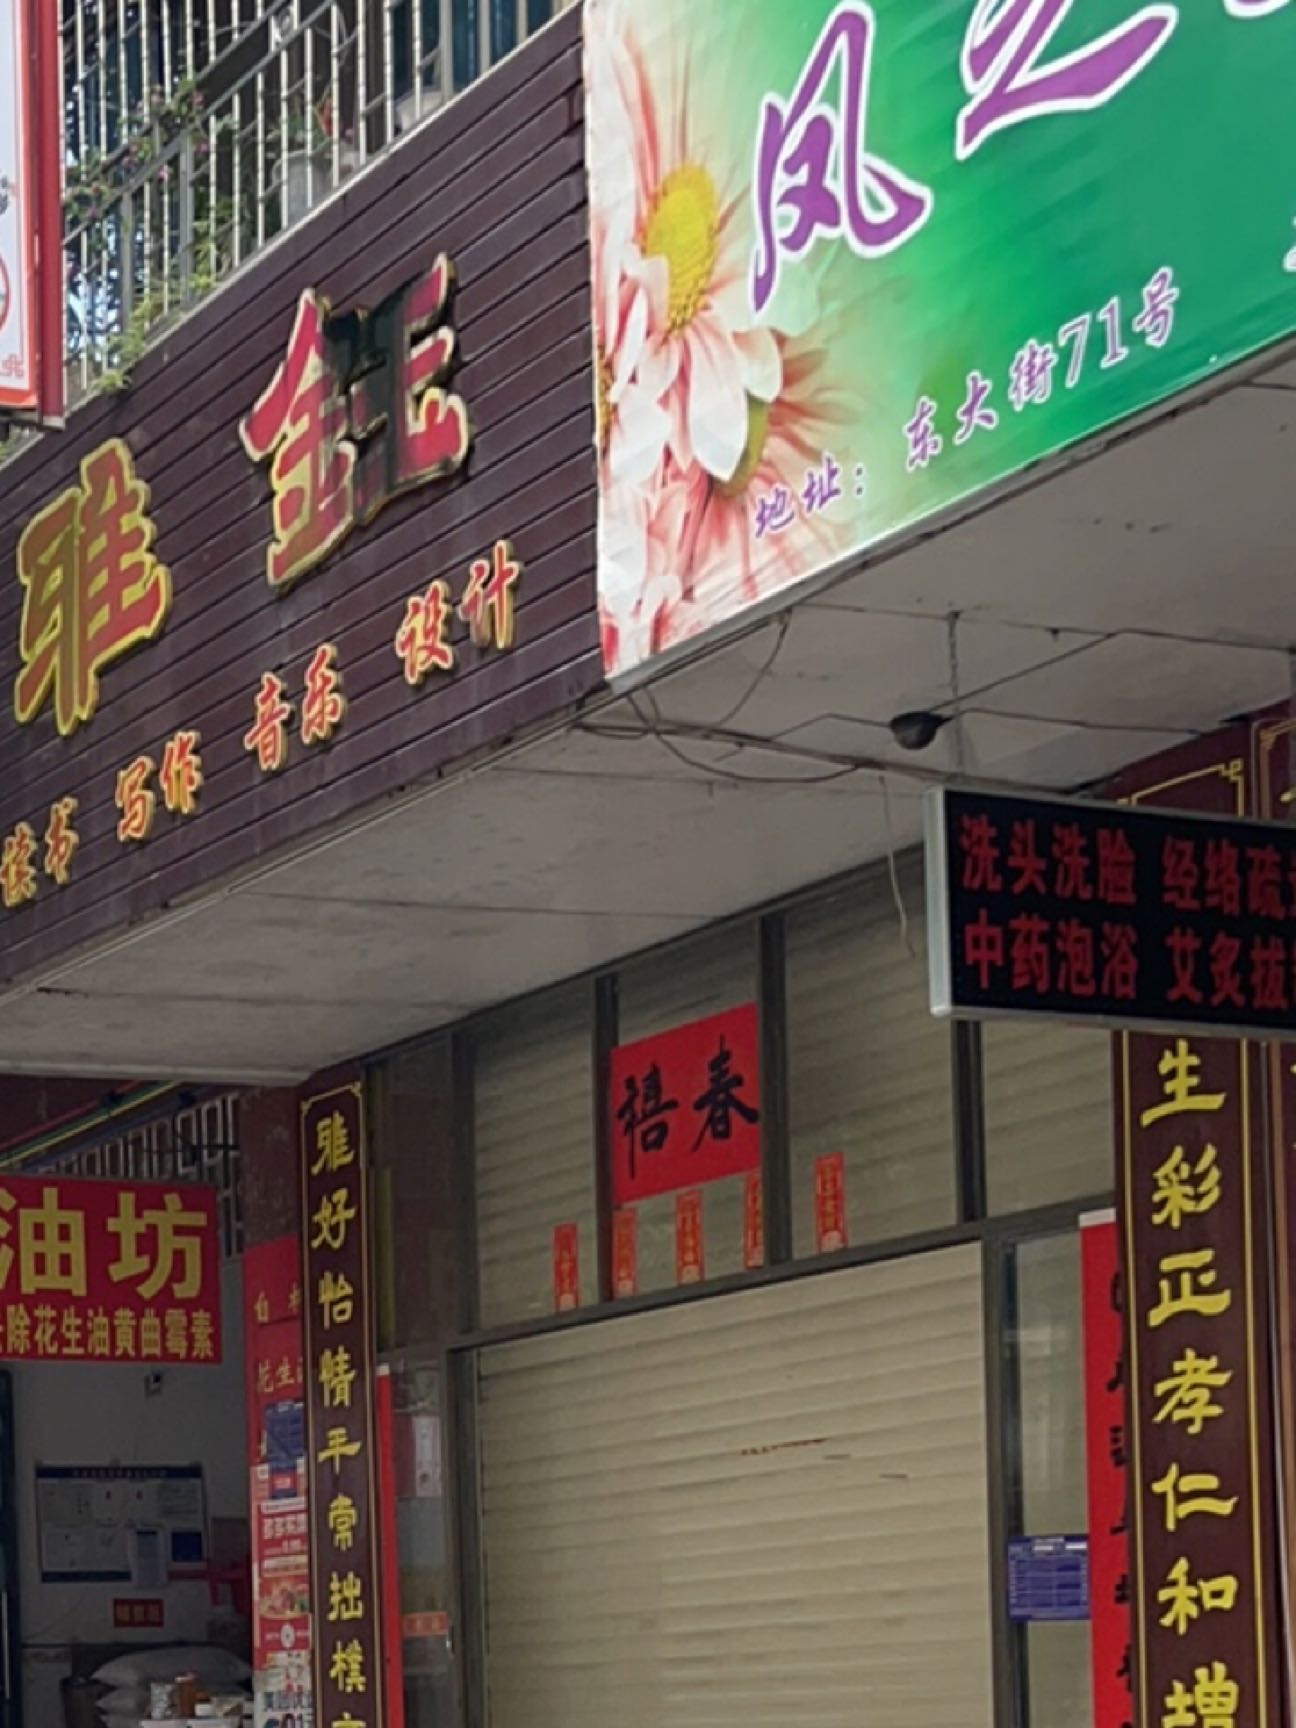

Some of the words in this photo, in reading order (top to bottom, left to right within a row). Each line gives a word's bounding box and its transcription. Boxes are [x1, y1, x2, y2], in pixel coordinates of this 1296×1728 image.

[903, 267, 1182, 470] 东大街71号
[244, 643, 345, 771] 音乐
[395, 539, 522, 686] 设计
[959, 813, 1137, 906] 洗头洗脸
[1160, 836, 1296, 922] 经络疏
[963, 907, 1140, 1001] 中药泡浴
[1165, 926, 1296, 1011] 艾灸拔
